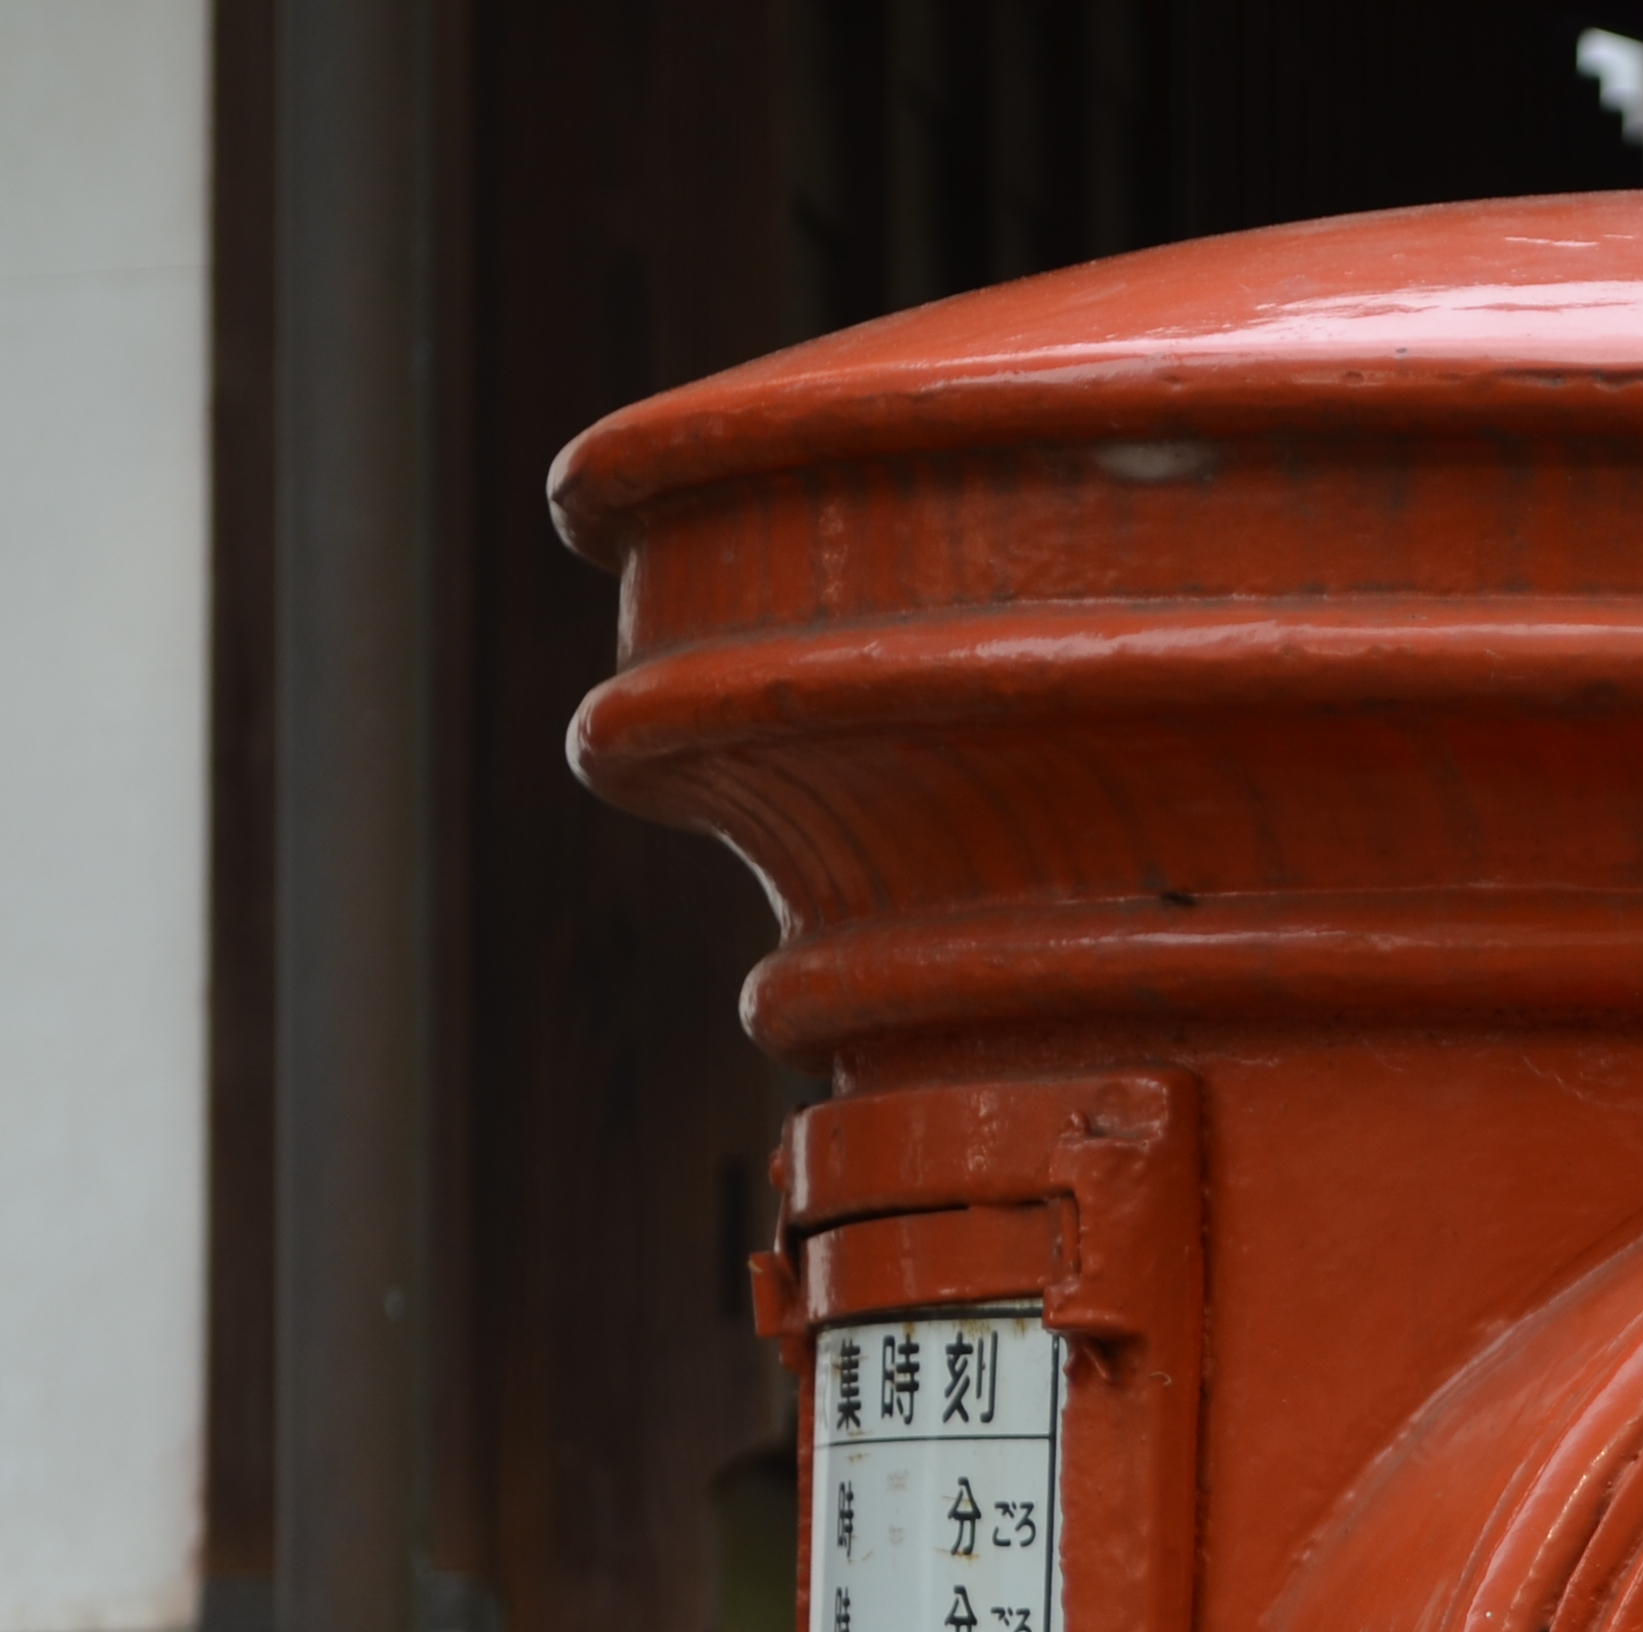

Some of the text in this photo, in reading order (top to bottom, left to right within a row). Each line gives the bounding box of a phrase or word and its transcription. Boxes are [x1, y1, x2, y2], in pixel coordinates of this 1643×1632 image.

[837, 1476, 1037, 1557] 時 分ごろ
